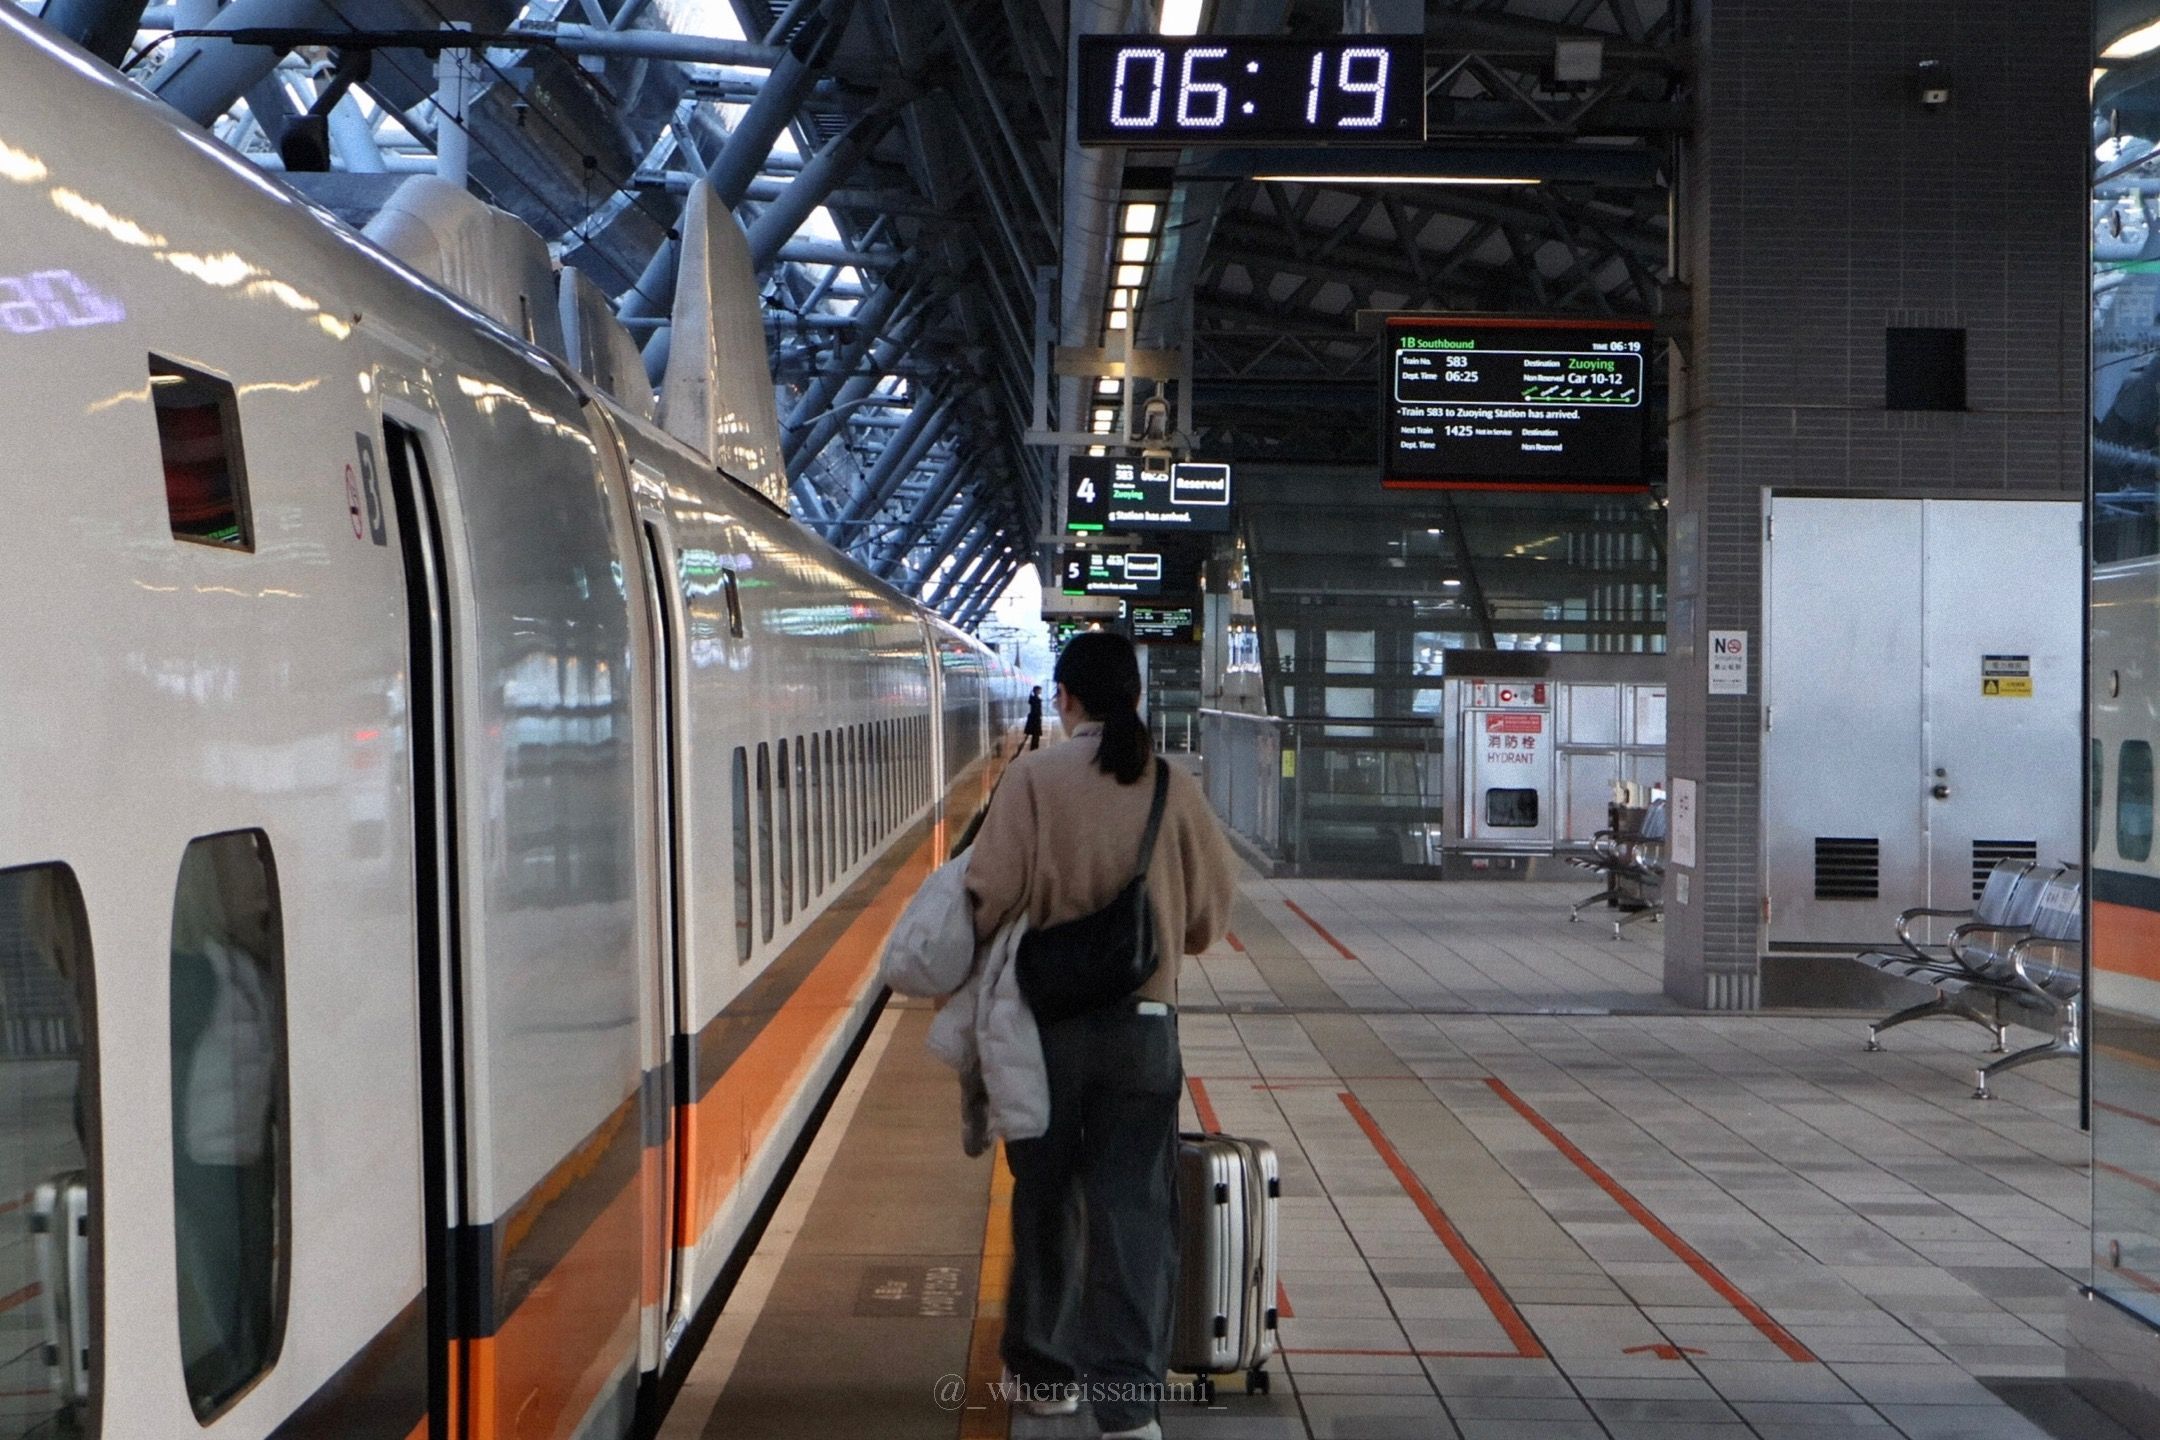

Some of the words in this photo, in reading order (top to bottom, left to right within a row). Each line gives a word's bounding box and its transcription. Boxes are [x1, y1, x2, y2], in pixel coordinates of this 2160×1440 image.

[1110, 48, 1390, 126] 06:19
[1401, 337, 1416, 348] 1B
[1417, 339, 1475, 349] Southbound
[1610, 341, 1641, 351] 06:19
[1402, 357, 1420, 365] Train
[1446, 356, 1468, 367] 583
[1523, 359, 1561, 368] Destination
[1568, 358, 1615, 372] Zuoying
[1402, 372, 1419, 381] Dept.
[1420, 372, 1438, 380] Time
[1445, 371, 1479, 382] 06:25
[1567, 372, 1588, 384] Car
[1591, 373, 1623, 385] 10-12
[1401, 407, 1425, 417] Train
[1426, 407, 1443, 417] 583
[1445, 408, 1455, 417] to
[1457, 408, 1493, 419] Zuoying
[1495, 409, 1526, 418] Station
[1528, 409, 1544, 419] has
[1546, 410, 1580, 419] arrived.
[1401, 427, 1416, 435] Next
[1417, 426, 1433, 435] Train
[1444, 425, 1473, 436] 1425
[1522, 428, 1559, 436] Destination
[1400, 441, 1418, 450] Dept.
[1419, 441, 1436, 449] Time
[1076, 477, 1096, 503] 4
[1176, 478, 1225, 491] Reserved
[1113, 490, 1144, 500] Zuoying
[1115, 511, 1144, 521] Station
[1145, 511, 1160, 521] has
[1068, 562, 1080, 578] 5
[1488, 735, 1536, 749] 消防栓
[1487, 752, 1534, 764] HYDRANT
